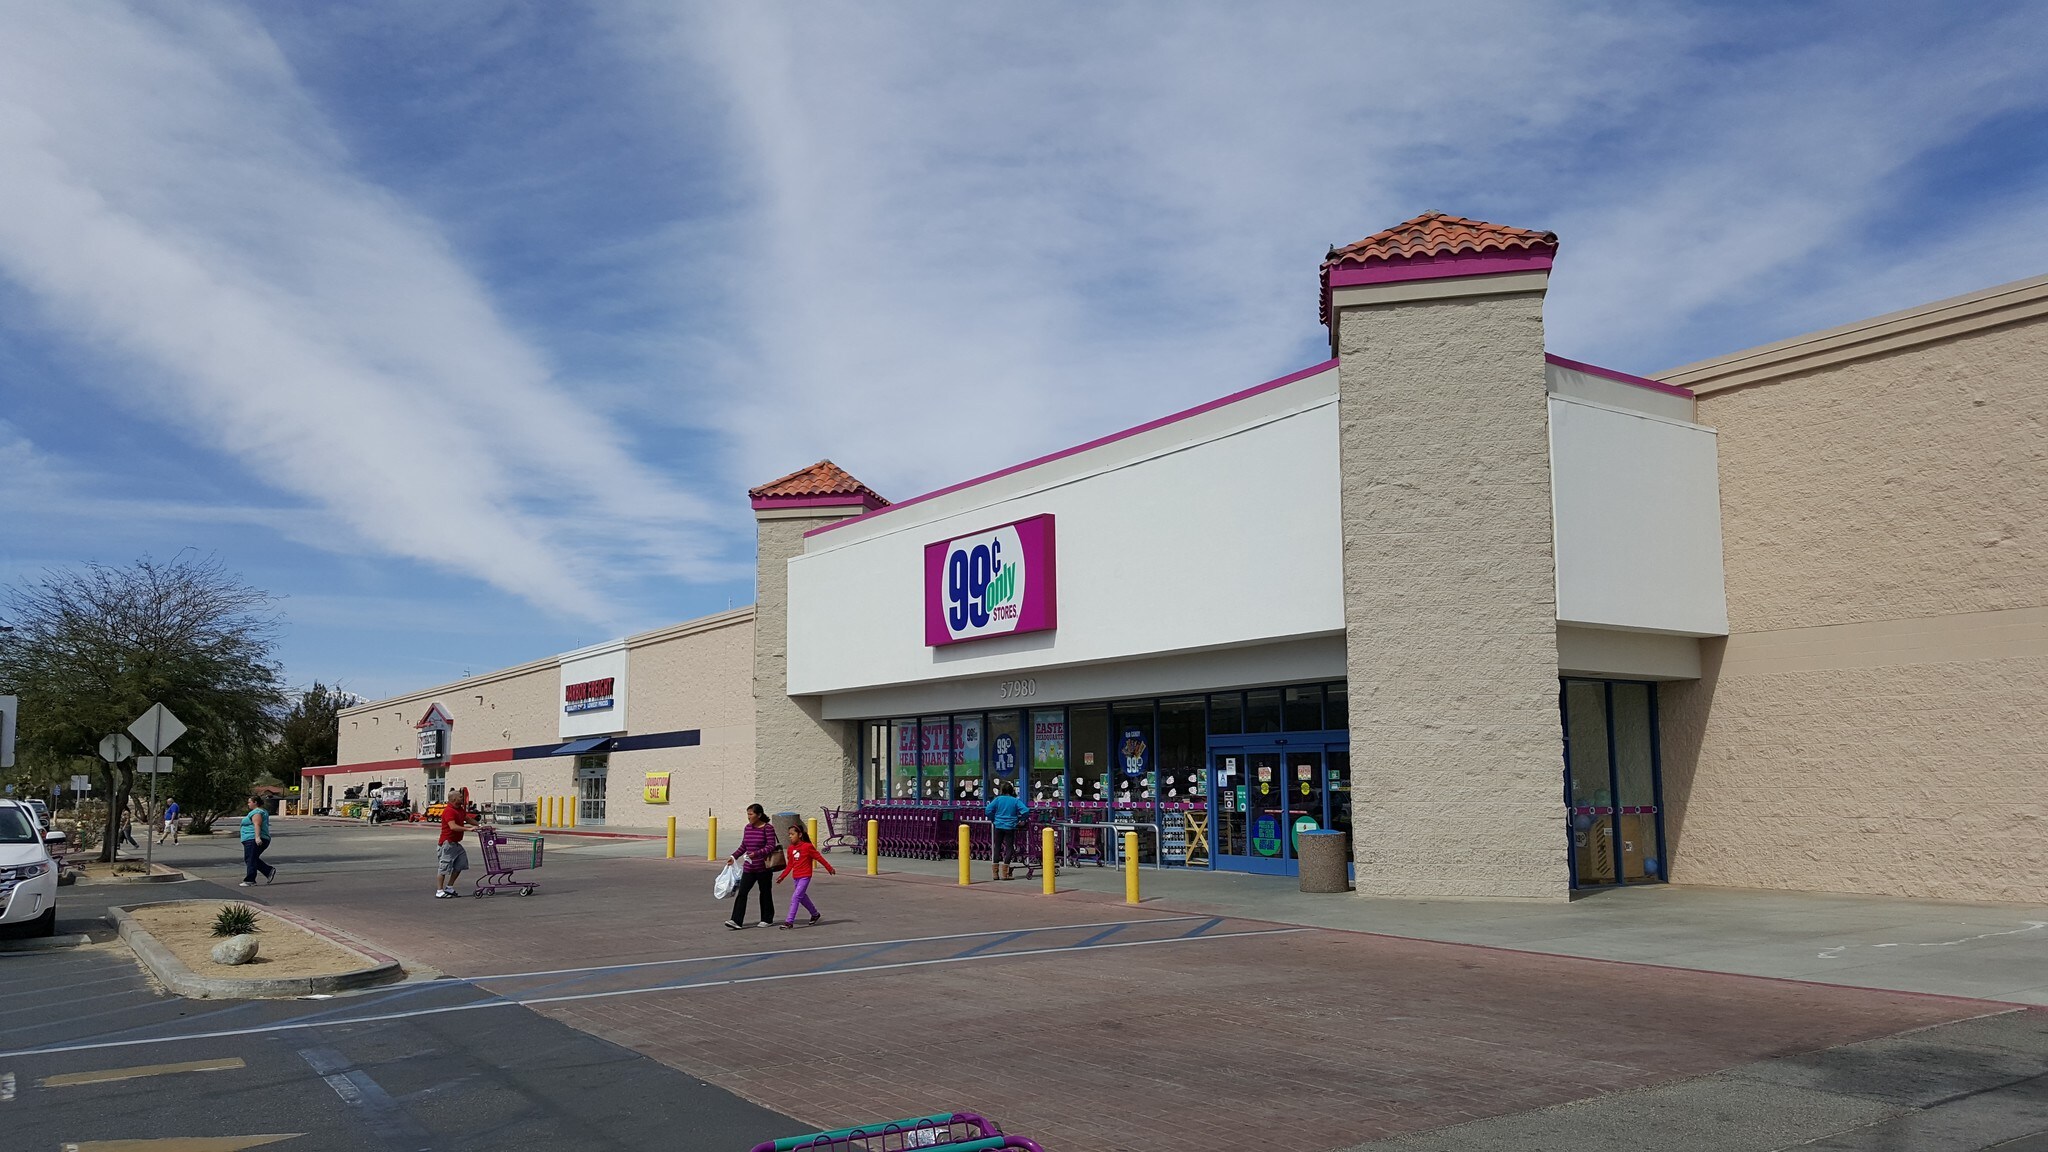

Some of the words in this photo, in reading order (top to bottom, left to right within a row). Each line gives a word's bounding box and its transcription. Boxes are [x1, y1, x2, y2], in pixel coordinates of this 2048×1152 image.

[986, 562, 1016, 612] only
[993, 604, 1018, 621] STORES
[566, 682, 587, 701] HARBOR
[588, 678, 612, 698] FREIGHT
[1001, 679, 1036, 698] 57980
[1036, 722, 1063, 734] EASTE
[899, 724, 964, 750] EASTER
[899, 750, 963, 767] HEAQUARTRS
[645, 777, 668, 788] LIQUIDATION
[650, 788, 659, 798] SALE
